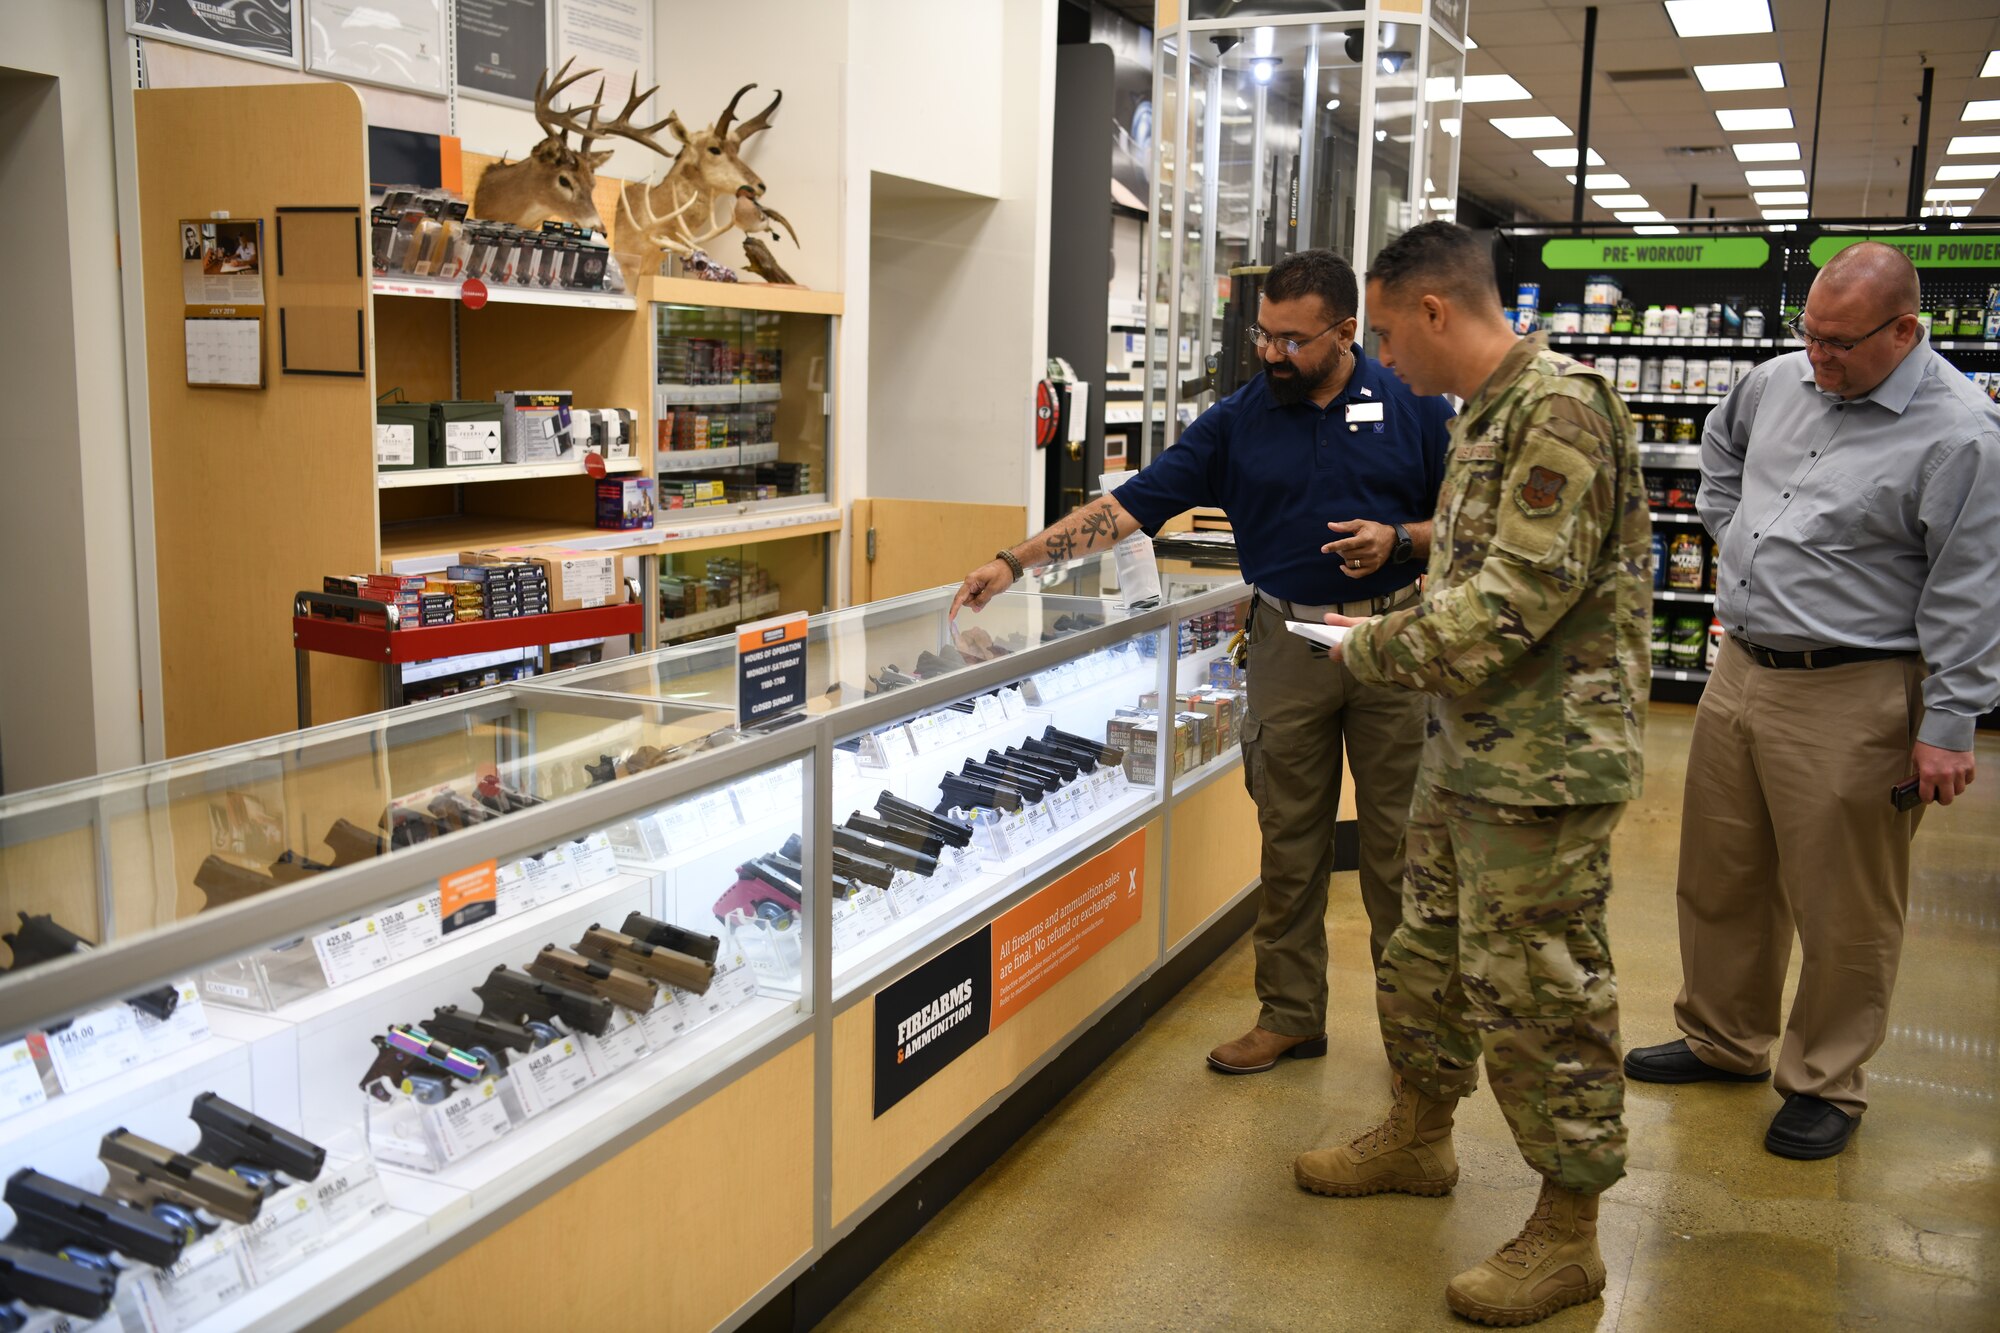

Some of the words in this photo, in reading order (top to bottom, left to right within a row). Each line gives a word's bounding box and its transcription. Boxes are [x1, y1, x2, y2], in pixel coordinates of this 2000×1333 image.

[1602, 246, 1704, 262] PRE-WORKOUT
[744, 651, 764, 664] HOURS
[764, 649, 772, 659] OF
[772, 642, 802, 657] OPERATION
[746, 657, 800, 679] MONDAY-SATURDAY
[751, 700, 772, 714] CLOSED
[772, 694, 794, 708] SUNDAY
[1110, 731, 1130, 739] CRITICA
[1110, 738, 1130, 746] DEFENS
[1000, 940, 1011, 960] All
[1012, 921, 1044, 951] firearms
[1044, 908, 1059, 930] and
[1060, 882, 1104, 919] ammunition
[1104, 872, 1120, 890] sales
[326, 931, 352, 947] 425.00
[1000, 962, 1013, 980] are
[1013, 945, 1034, 970] final.
[1034, 937, 1046, 956] No
[1047, 917, 1071, 947] refund
[1072, 914, 1080, 928] or
[1081, 891, 1118, 922] exchanges.
[1000, 978, 1019, 997] Defective
[1000, 995, 1011, 1008] Refer
[897, 978, 972, 1047] FIREARMS
[58, 1026, 94, 1047] 545.00
[897, 1048, 905, 1064] &
[904, 1001, 972, 1060] AMMUNITION
[317, 1177, 348, 1201] 495.00
